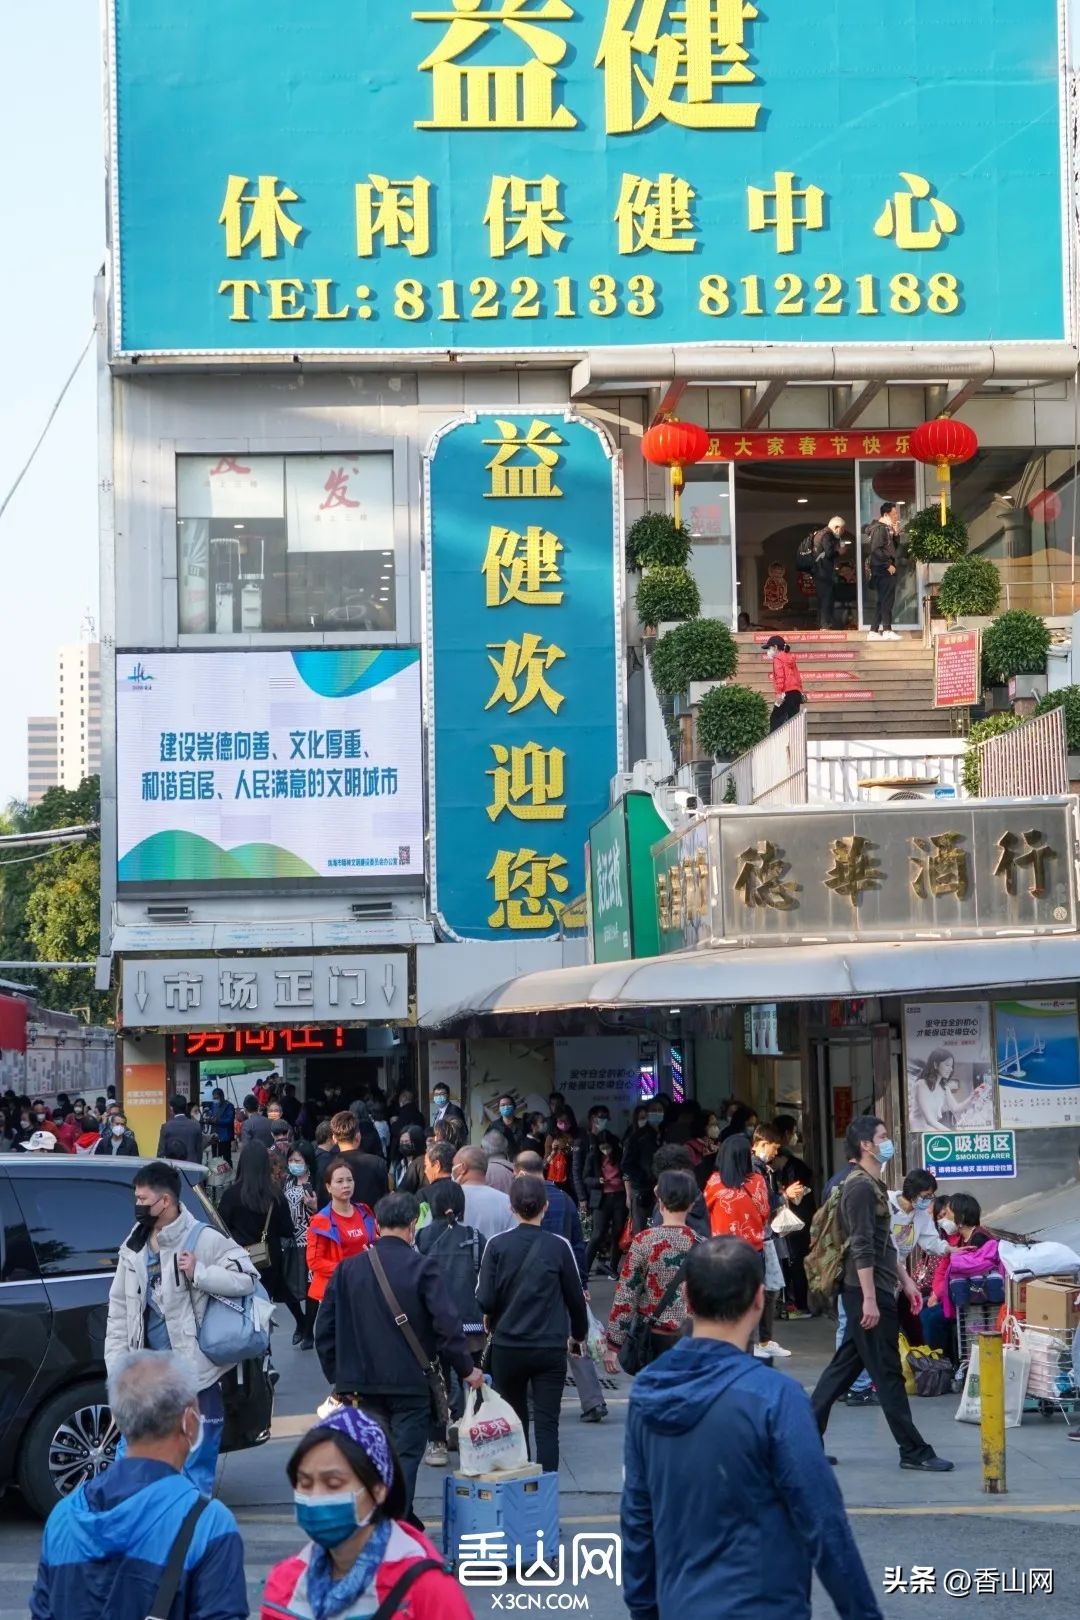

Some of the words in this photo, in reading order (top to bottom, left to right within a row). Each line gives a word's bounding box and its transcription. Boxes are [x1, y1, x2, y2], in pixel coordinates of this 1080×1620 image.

[414, 0, 761, 134] 益健
[218, 172, 957, 258] 休闲保健中心
[699, 272, 959, 316] 8122188
[705, 435, 910, 456] 祝大家春节快乐
[482, 418, 569, 930] 益健欢迎您
[160, 729, 369, 762] 建设崇德向善、文化厚重、
[141, 767, 398, 800] 和谐宜居、人民满意的文明城市
[163, 965, 367, 1011] 市场正门
[954, 1134, 1011, 1152] 吸烟区
[955, 1153, 990, 1161] SMOKING
